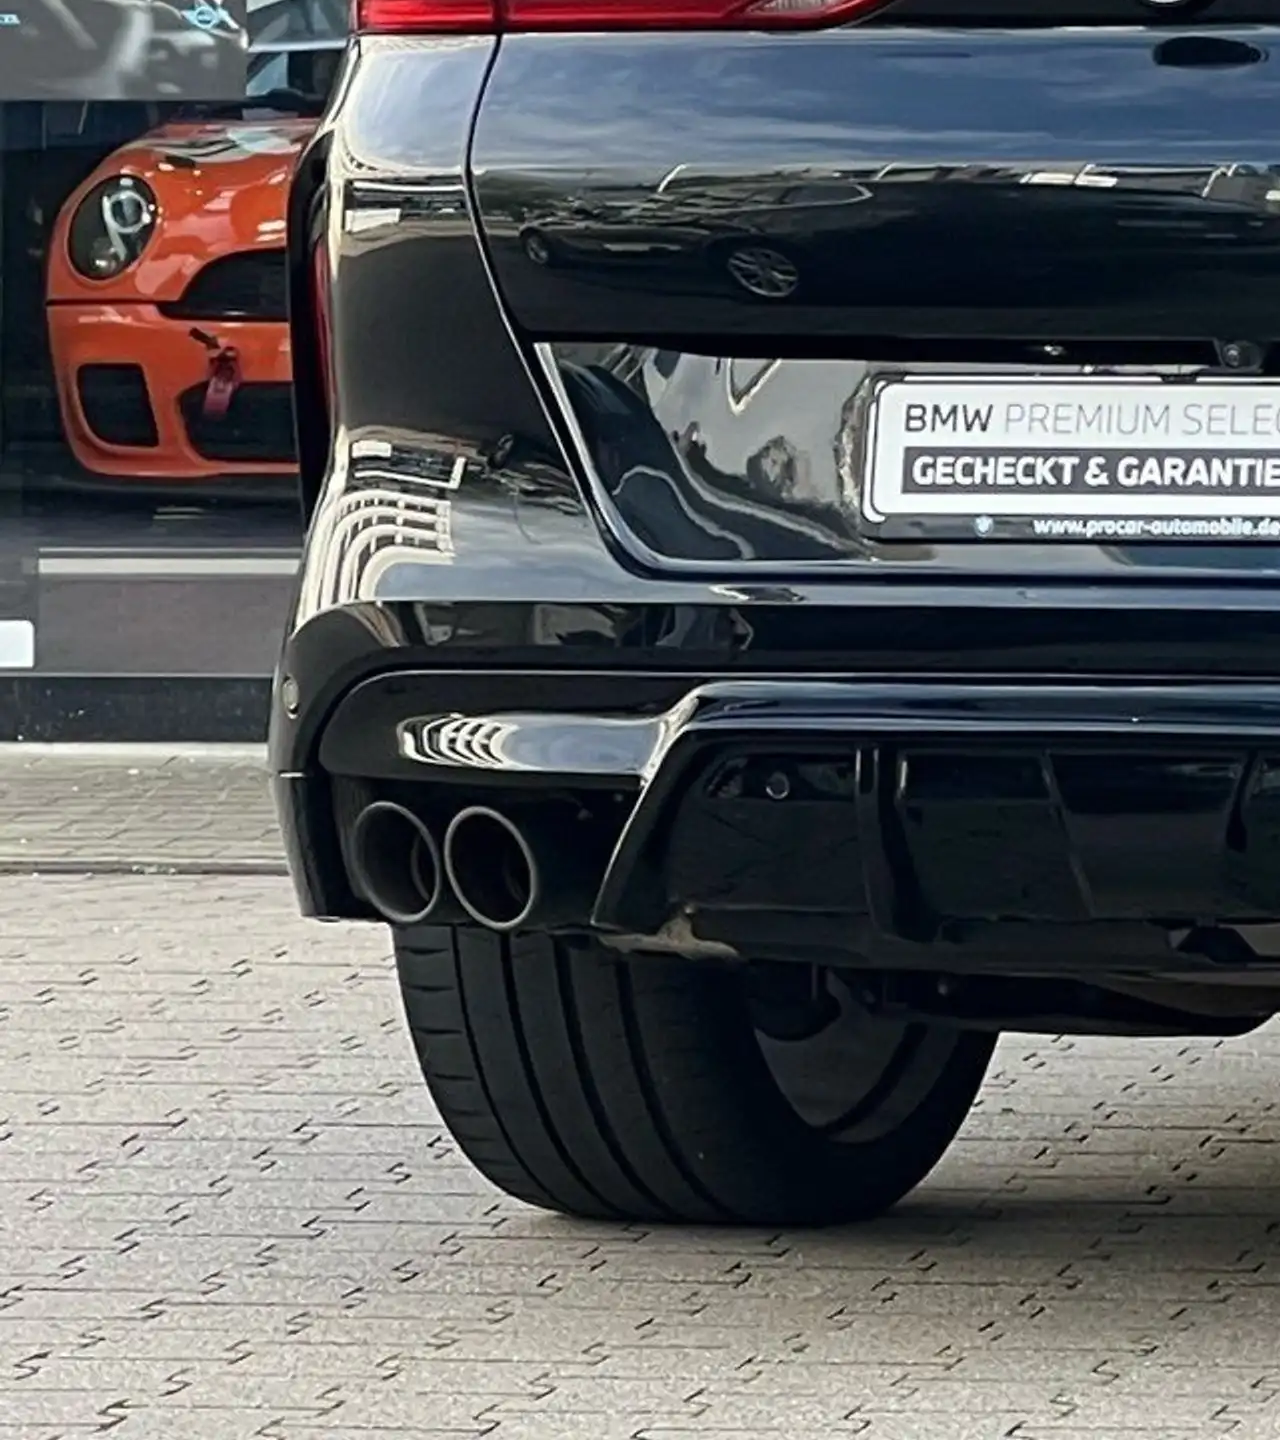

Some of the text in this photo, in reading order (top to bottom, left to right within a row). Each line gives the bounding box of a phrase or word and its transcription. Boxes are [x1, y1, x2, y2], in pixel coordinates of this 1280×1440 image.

[904, 403, 994, 432] BMW
[1004, 403, 1171, 436] PREMIUM
[911, 455, 1081, 486] GECHECKT
[1083, 457, 1110, 486] &
